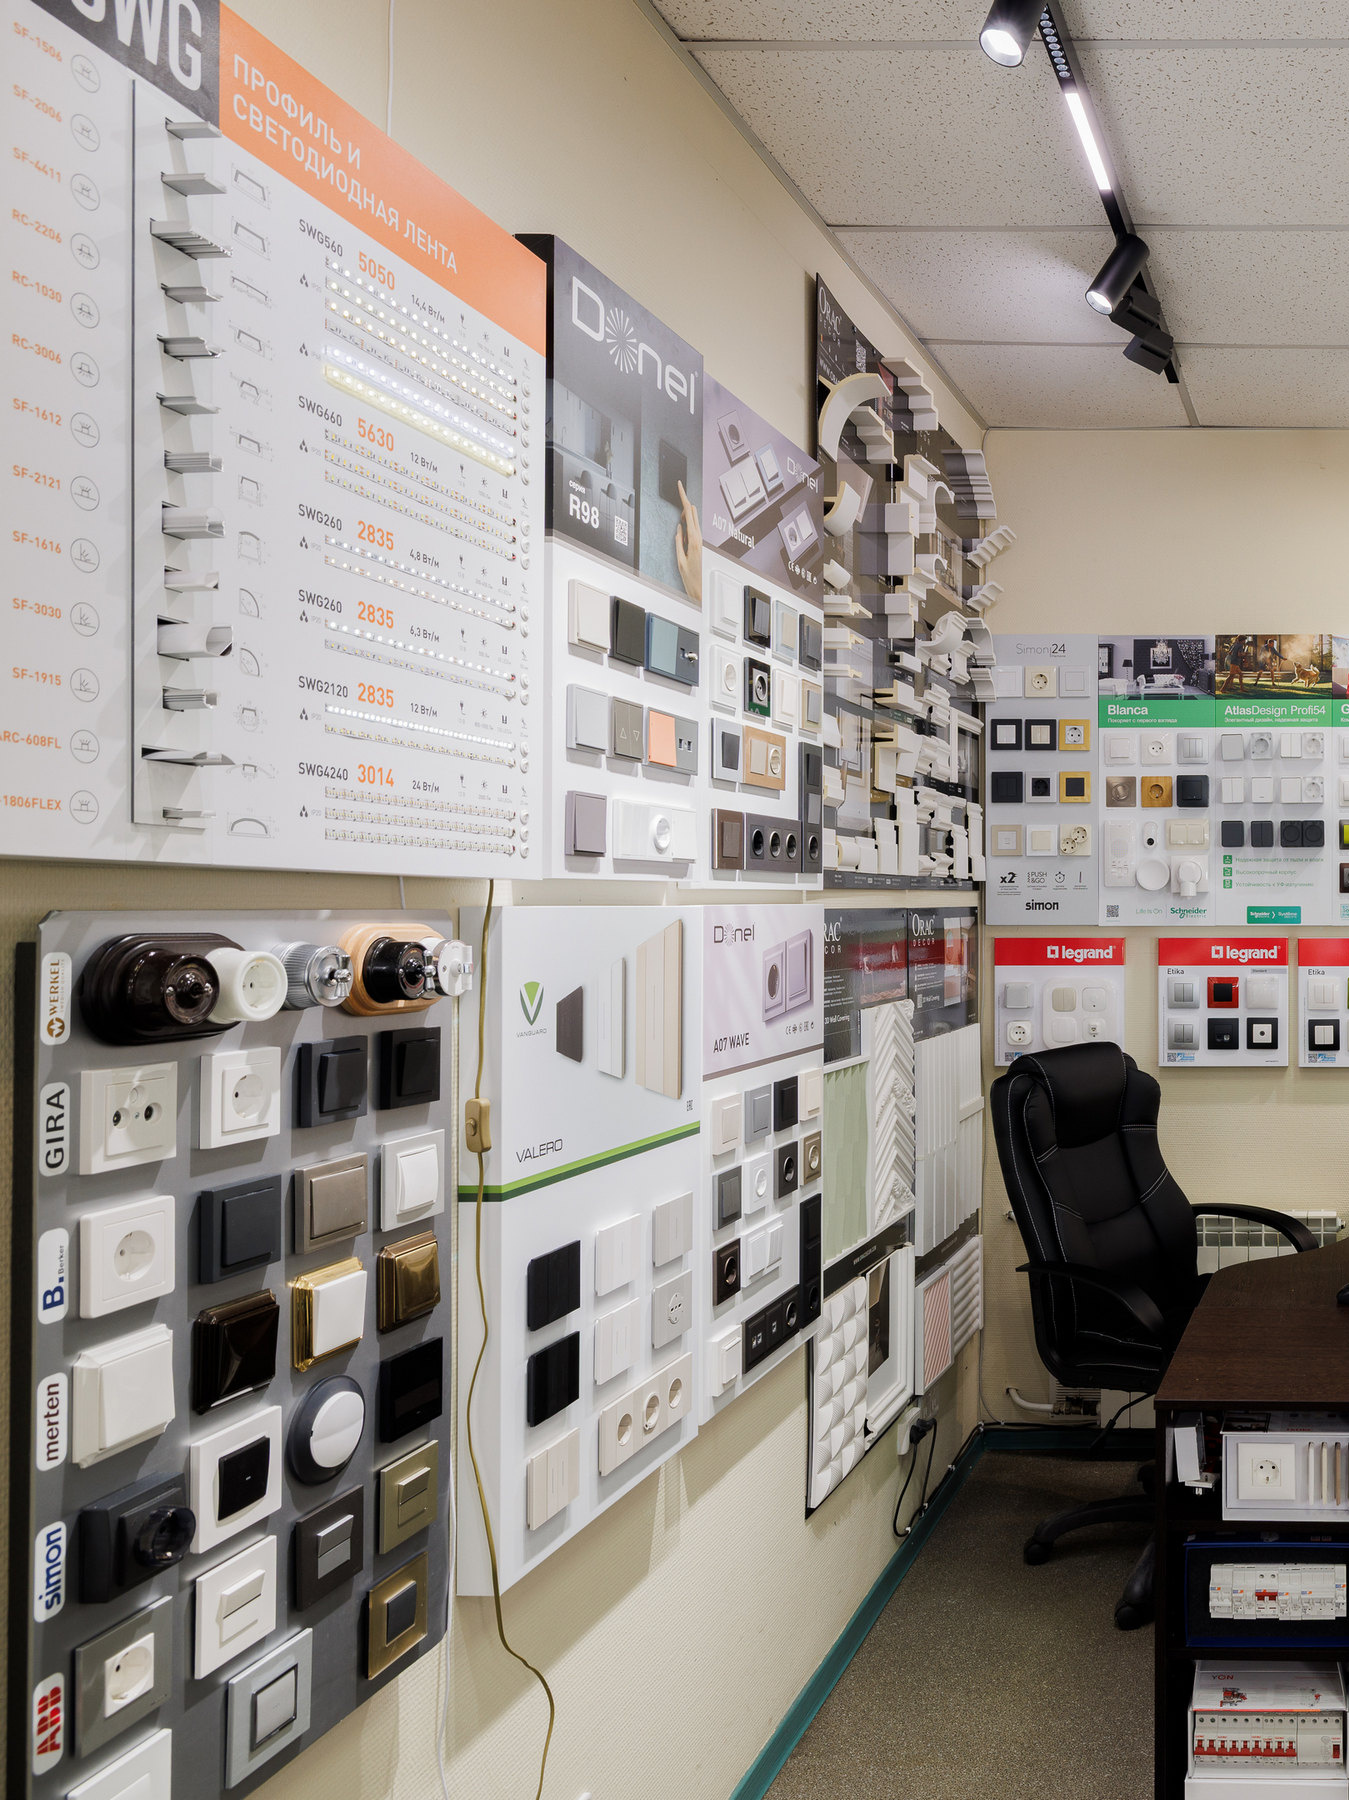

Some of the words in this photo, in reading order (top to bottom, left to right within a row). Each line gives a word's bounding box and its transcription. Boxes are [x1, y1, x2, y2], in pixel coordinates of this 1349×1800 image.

[13, 22, 62, 62] SF-1506
[13, 84, 62, 122] SF-2006
[234, 54, 342, 154] ПРОФИЛЬ
[348, 141, 361, 170] И
[13, 147, 62, 183] SF-4411
[233, 94, 400, 232] СВЕТОДИОДНАЯ
[404, 219, 458, 274] ЛЕНТА
[12, 209, 62, 244] RC-2206
[299, 219, 344, 257] SWG560
[358, 251, 395, 291] 5050
[12, 270, 62, 303] RC-1030
[411, 294, 427, 310] 14,4
[428, 305, 446, 324] Вт/м
[12, 334, 62, 364] RC-3006
[13, 398, 62, 426] SF-1612
[298, 395, 342, 427] SWG660
[358, 418, 395, 452] 5630
[410, 452, 420, 464] 12
[421, 456, 438, 474] Вт/м
[12, 465, 61, 490] SF-2121
[568, 479, 587, 495] серия
[298, 503, 342, 531] SWG260
[569, 494, 600, 529] R98
[12, 530, 62, 554] SF-1616
[358, 520, 395, 552] 2835
[712, 513, 728, 532] A07
[728, 517, 756, 550] Natural
[409, 549, 421, 560] 4,8
[422, 551, 440, 569] Вт/м
[12, 598, 62, 619] SF-3030
[298, 589, 342, 614] SWG260
[358, 601, 395, 629] 2835
[410, 625, 421, 637] 6,3
[422, 628, 440, 643] Вт/м
[1015, 642, 1050, 655] Simon
[1051, 643, 1066, 654] 24
[12, 667, 62, 686] SF-1915
[298, 675, 349, 698] SWG2120
[358, 682, 395, 708] 2835
[410, 702, 420, 712] 12
[421, 704, 438, 718] Вт/м
[1107, 704, 1149, 715] Blanca
[1224, 705, 1288, 718] AtlasDesign
[1290, 705, 1326, 715] Profi54
[298, 762, 349, 781] SWG4240
[357, 764, 395, 787] 3014
[412, 780, 422, 790] 24
[422, 781, 440, 793] Вт/м
[1025, 899, 1059, 911] simon
[1136, 907, 1146, 915] Life
[1152, 907, 1163, 915] On
[1170, 907, 1208, 917] Schneider
[912, 914, 935, 938] ORAC
[912, 938, 935, 948] DECOR
[1061, 945, 1113, 963] legrand
[1226, 945, 1278, 963] legrand
[49, 958, 61, 1016] WERKEL
[516, 1027, 548, 1039] VANGUARD
[713, 1036, 728, 1054] A07
[728, 1032, 750, 1049] WAVE
[45, 1088, 66, 1169] GIRA
[516, 1138, 564, 1164] VALERO
[57, 1245, 65, 1275] Berker
[43, 1382, 59, 1462] merten
[39, 1527, 62, 1610] simon
[37, 1686, 62, 1755] ABB
